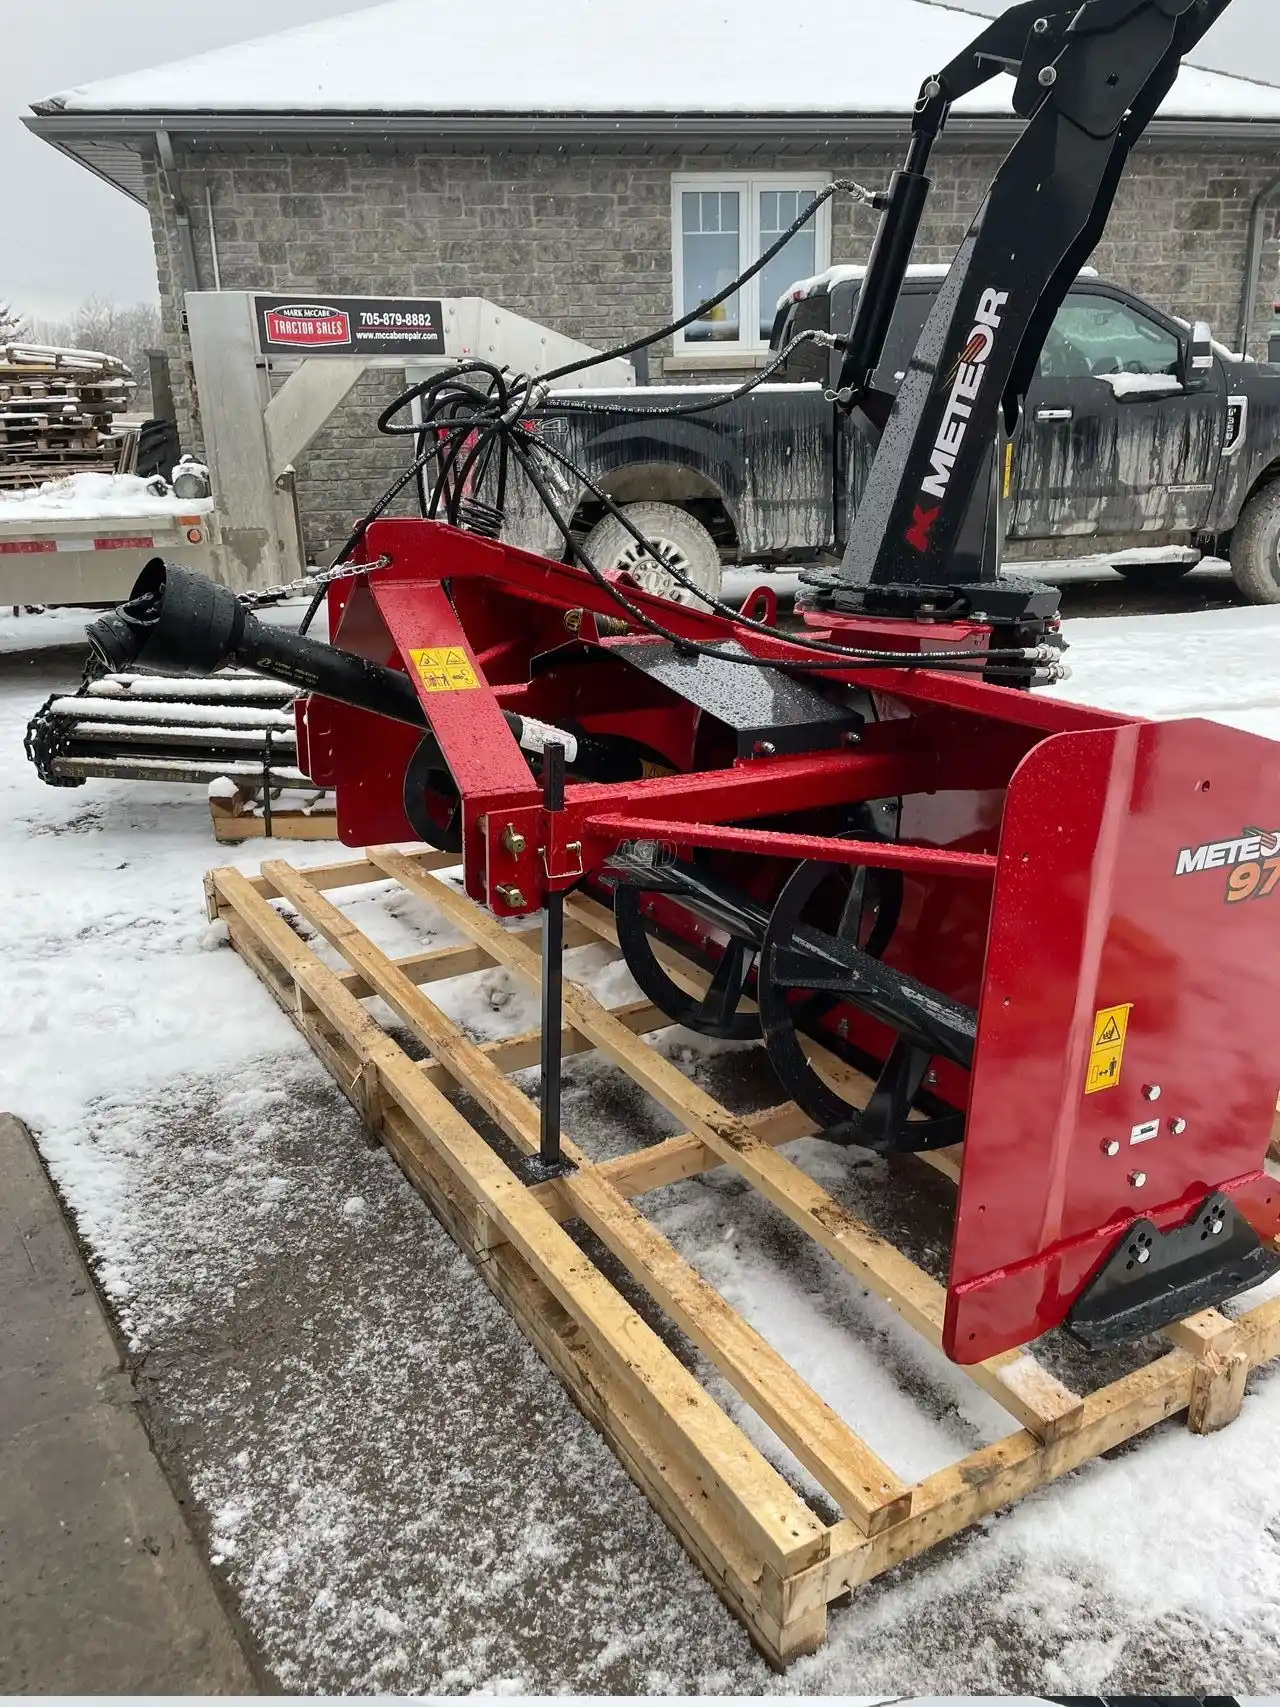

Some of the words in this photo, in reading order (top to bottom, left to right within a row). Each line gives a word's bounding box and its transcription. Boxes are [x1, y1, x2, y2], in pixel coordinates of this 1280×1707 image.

[283, 309, 303, 318] MARK
[360, 312, 432, 326] 705-879-8882
[274, 319, 314, 335] TRACTOR
[355, 331, 438, 341] www.mccaberepair.com
[921, 287, 1010, 499] METEOR
[1175, 831, 1280, 875] METEO
